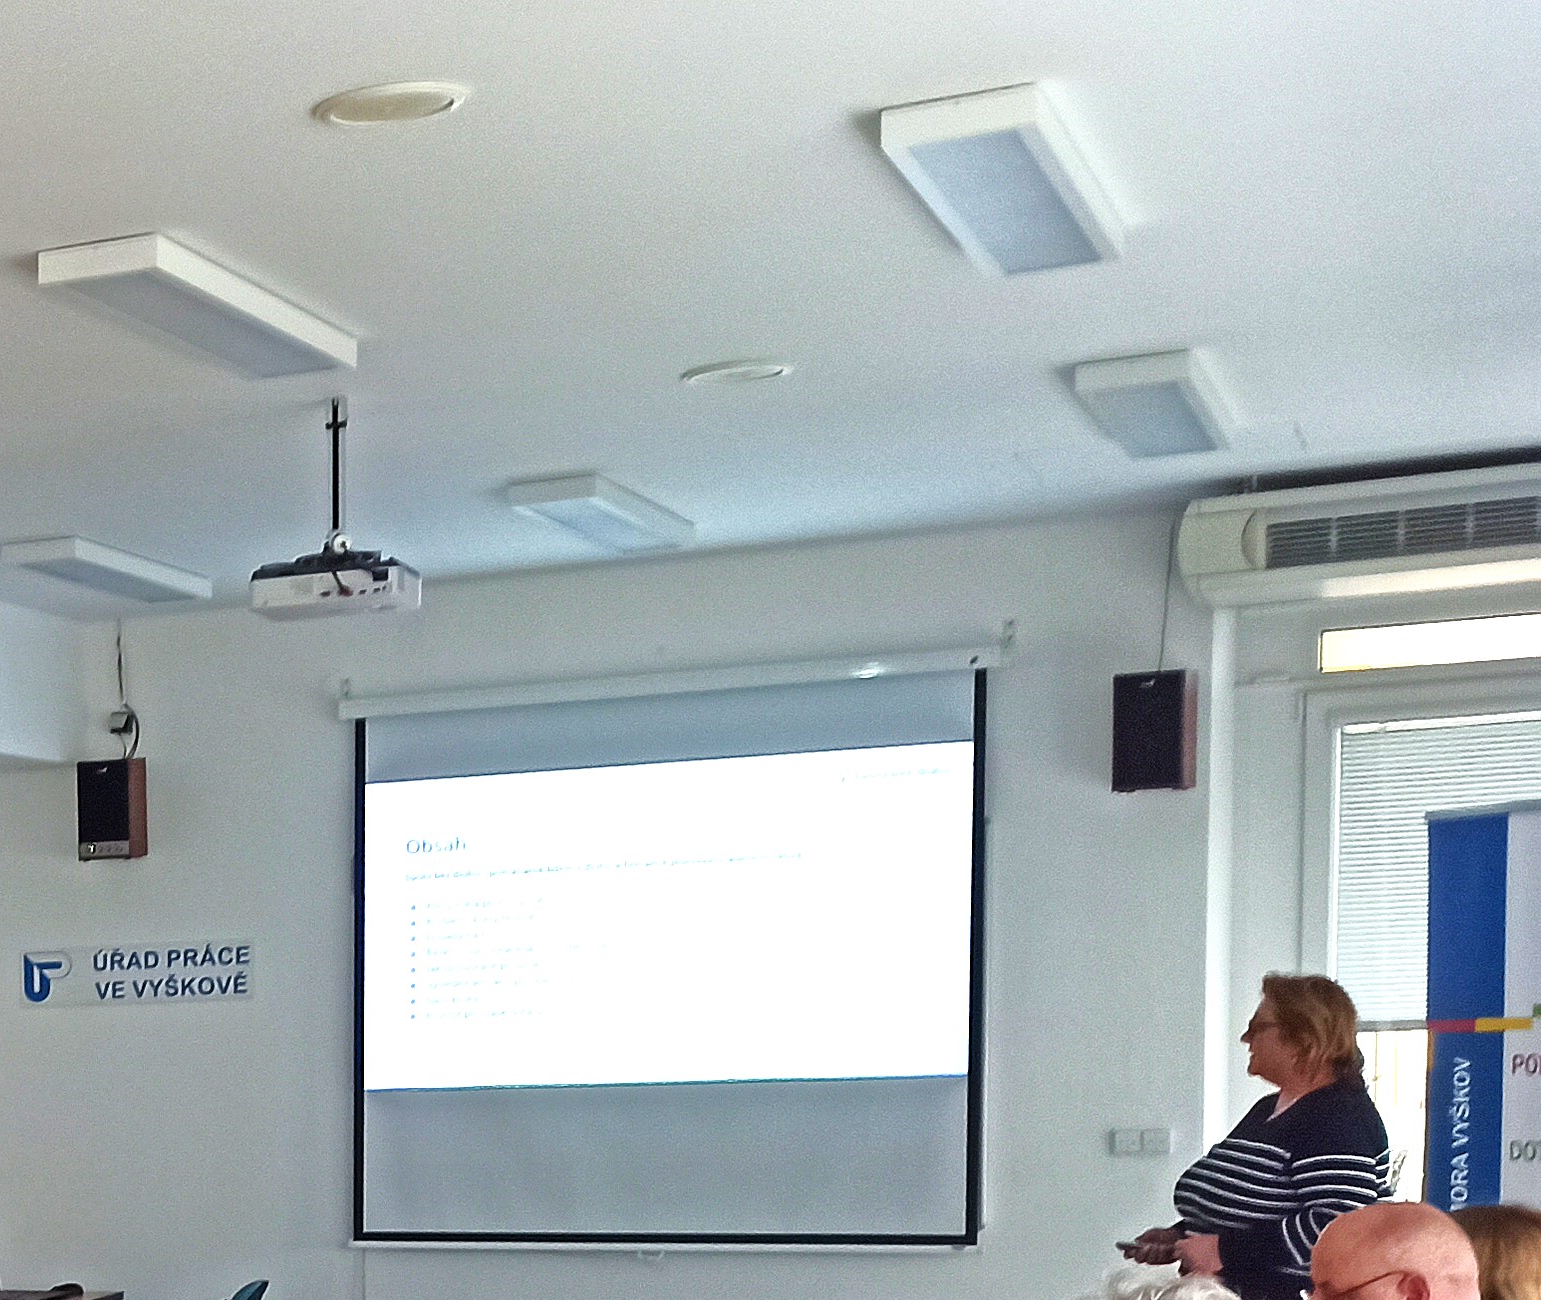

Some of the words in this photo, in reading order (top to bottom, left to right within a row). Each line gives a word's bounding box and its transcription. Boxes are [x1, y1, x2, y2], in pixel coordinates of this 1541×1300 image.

[406, 835, 466, 854] Obsah
[93, 948, 160, 972] ÚŘAD
[167, 942, 252, 969] PRÁCE
[95, 980, 125, 1000] VE
[1511, 1053, 1541, 1075] PO
[1448, 1056, 1471, 1149] VYŠKOV
[1449, 1152, 1470, 1211] ORA
